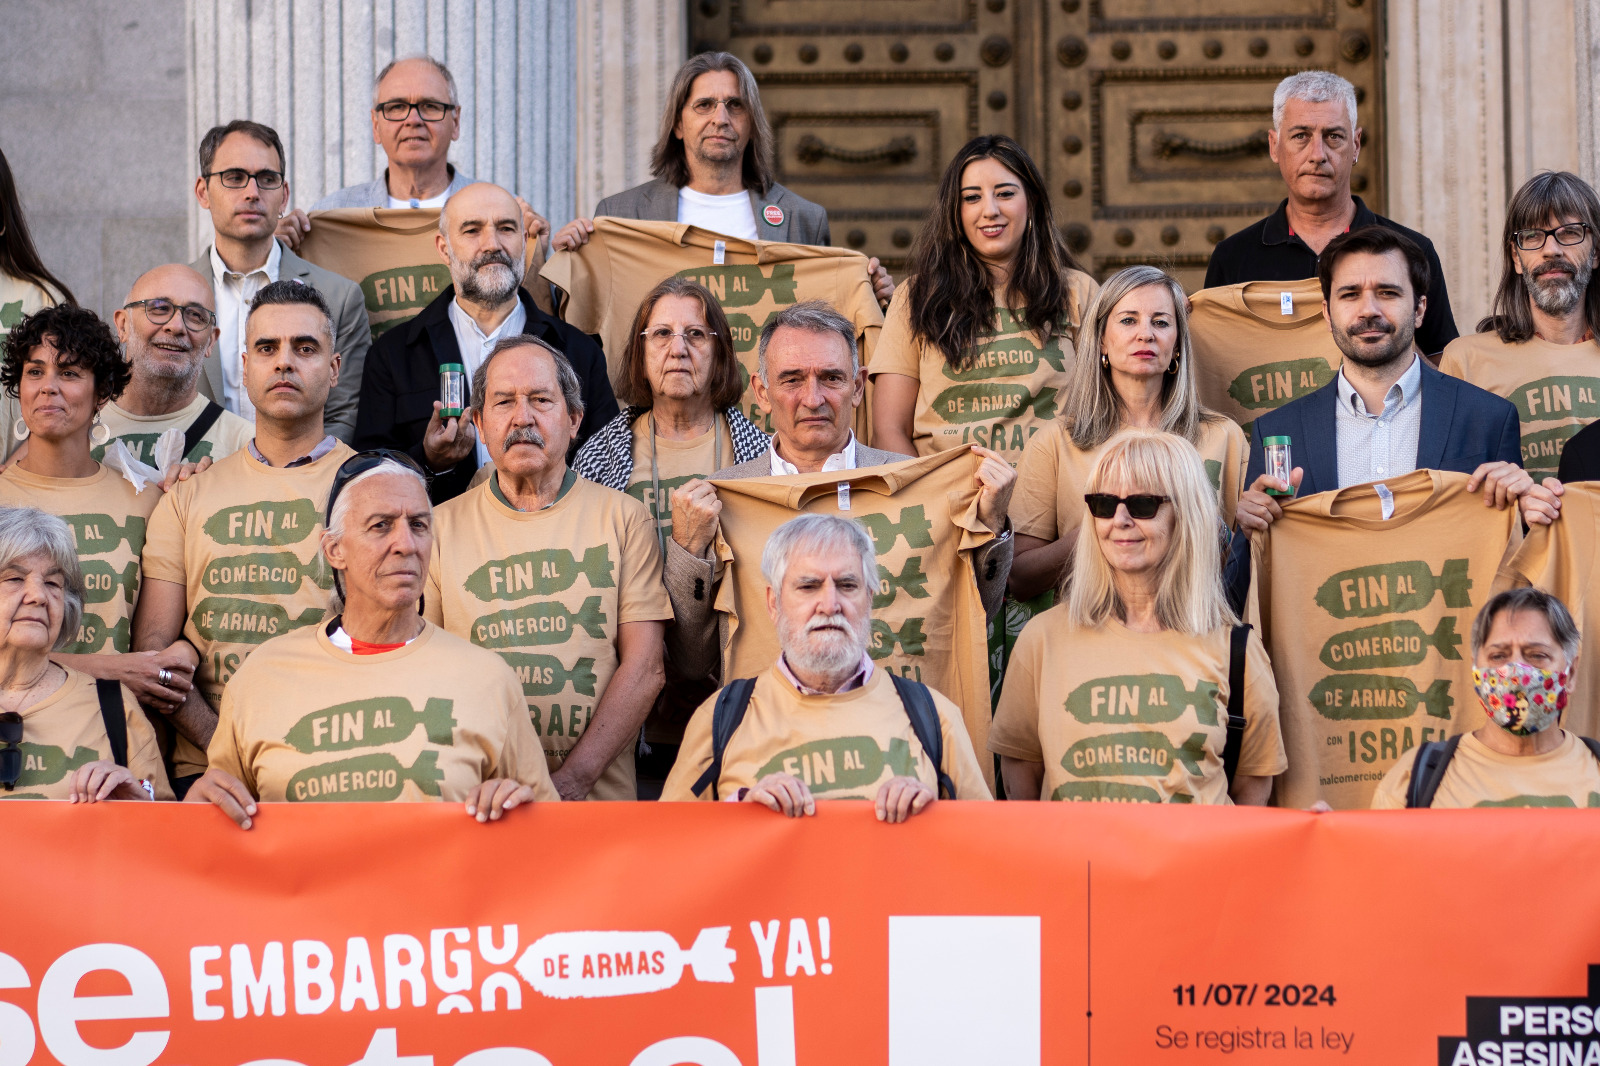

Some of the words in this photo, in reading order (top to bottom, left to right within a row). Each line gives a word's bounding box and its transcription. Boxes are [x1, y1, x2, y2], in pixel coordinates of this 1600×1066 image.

[374, 275, 417, 306] FIN
[422, 276, 438, 293] AL
[733, 276, 749, 292] AL
[1250, 371, 1293, 402] FIN
[1300, 371, 1318, 388] AL
[1525, 384, 1572, 416] FIN
[1578, 387, 1597, 405] AL
[947, 397, 965, 414] DE
[971, 394, 1022, 413] ARMAS
[84, 524, 104, 541] AL
[228, 510, 275, 539] FIN
[281, 512, 299, 530] AL
[209, 564, 297, 586] COMERCIO
[489, 561, 534, 594] FIN
[541, 561, 560, 579] AL
[1340, 575, 1390, 611] FIN
[1396, 575, 1417, 595] AL
[201, 611, 215, 628] DE
[219, 616, 279, 635] ARMAS
[477, 615, 567, 642] COMERCIO
[1330, 636, 1421, 663] COMERCIO
[1090, 685, 1140, 717] FIN
[1148, 687, 1168, 706] AL
[1325, 689, 1343, 707] DE
[1350, 689, 1408, 708] ARMAS
[312, 709, 364, 747] FIN
[373, 709, 396, 729] AL
[1326, 735, 1343, 746] CON
[25, 754, 48, 771] AL
[844, 749, 865, 771] AL
[1073, 744, 1168, 769] COMERCIO
[295, 769, 397, 801] COMERCIO
[543, 953, 570, 979] DE
[582, 950, 665, 979] ARMAS
[749, 916, 833, 979] YA!
[1264, 984, 1337, 1007] 2024
[1500, 1005, 1600, 1035] PERS
[1156, 1025, 1189, 1049] Se
[1195, 1026, 1287, 1054] registra
[1294, 1026, 1314, 1049] la
[1320, 1026, 1355, 1055] ley
